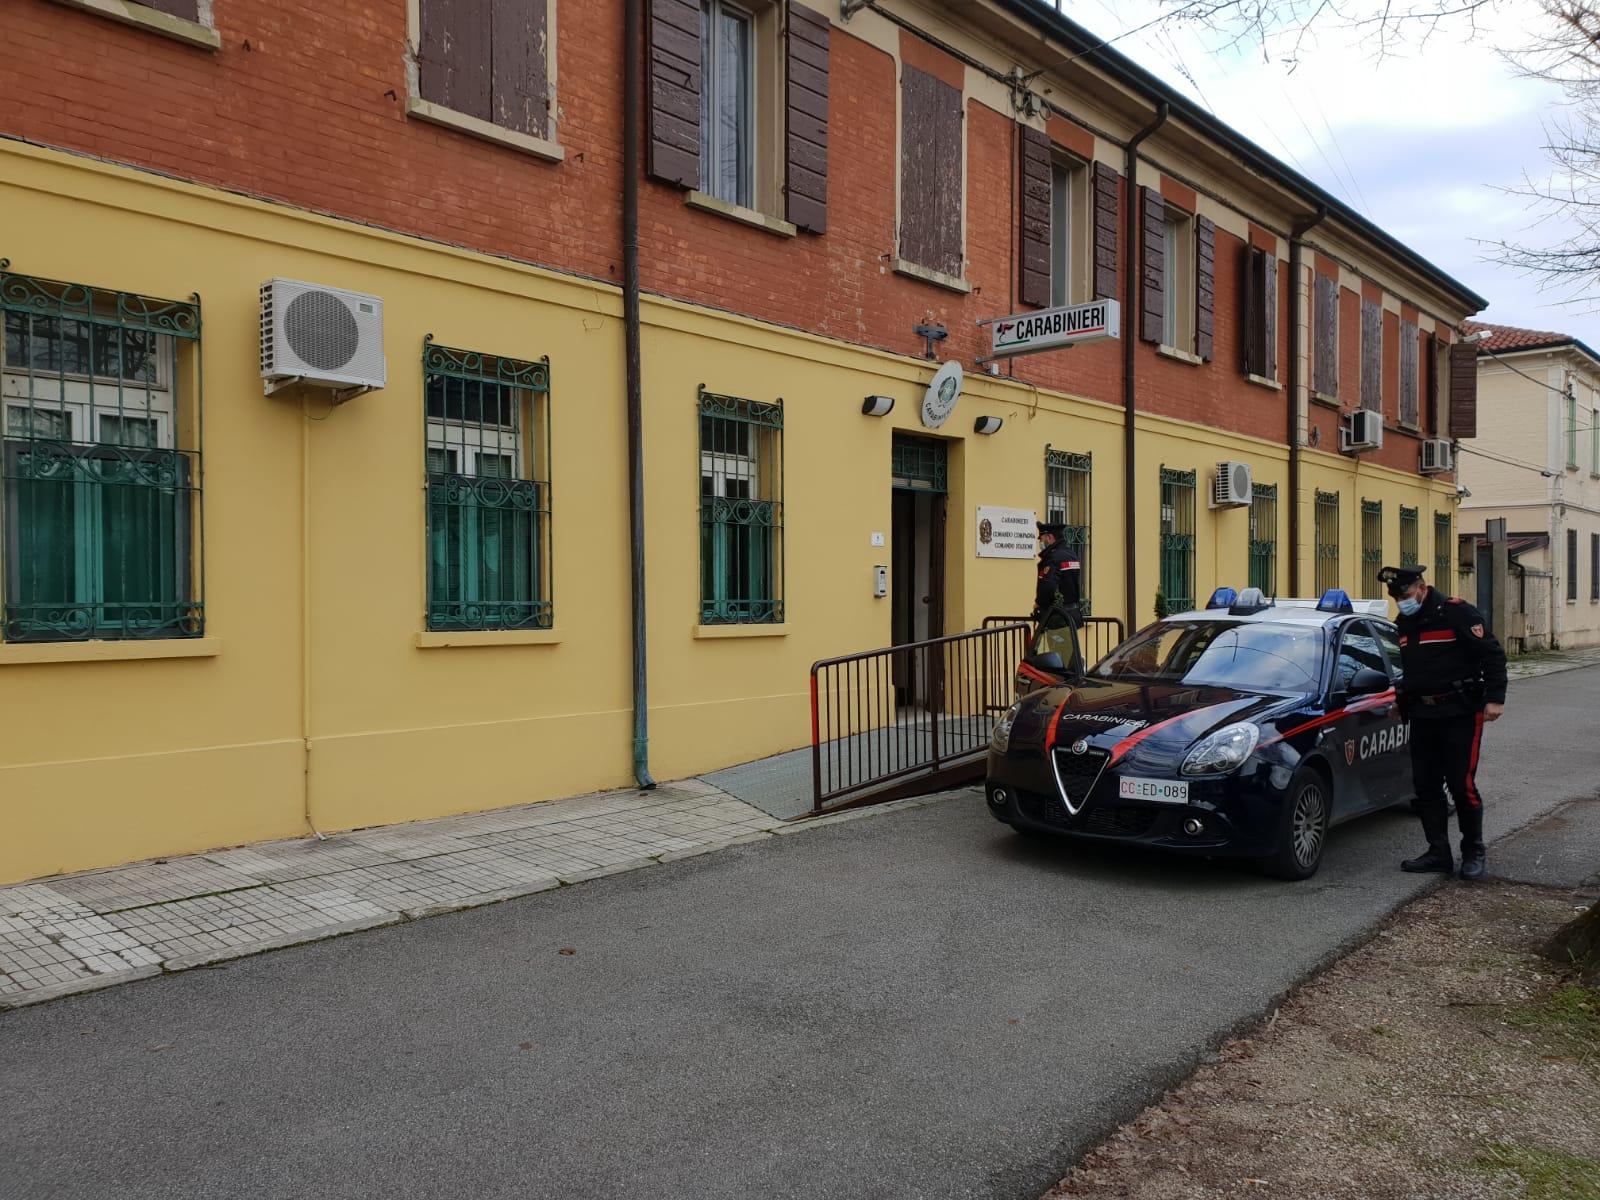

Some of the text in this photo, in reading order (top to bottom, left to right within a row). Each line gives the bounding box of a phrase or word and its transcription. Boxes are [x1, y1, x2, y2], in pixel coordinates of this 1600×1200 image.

[1016, 306, 1105, 340] CARABINIERI
[1001, 516, 1029, 525] CARABINIERI
[994, 542, 1015, 550] COMANDO
[1062, 713, 1150, 729] CARABINIERI
[1121, 781, 1187, 799] CC ED 089
